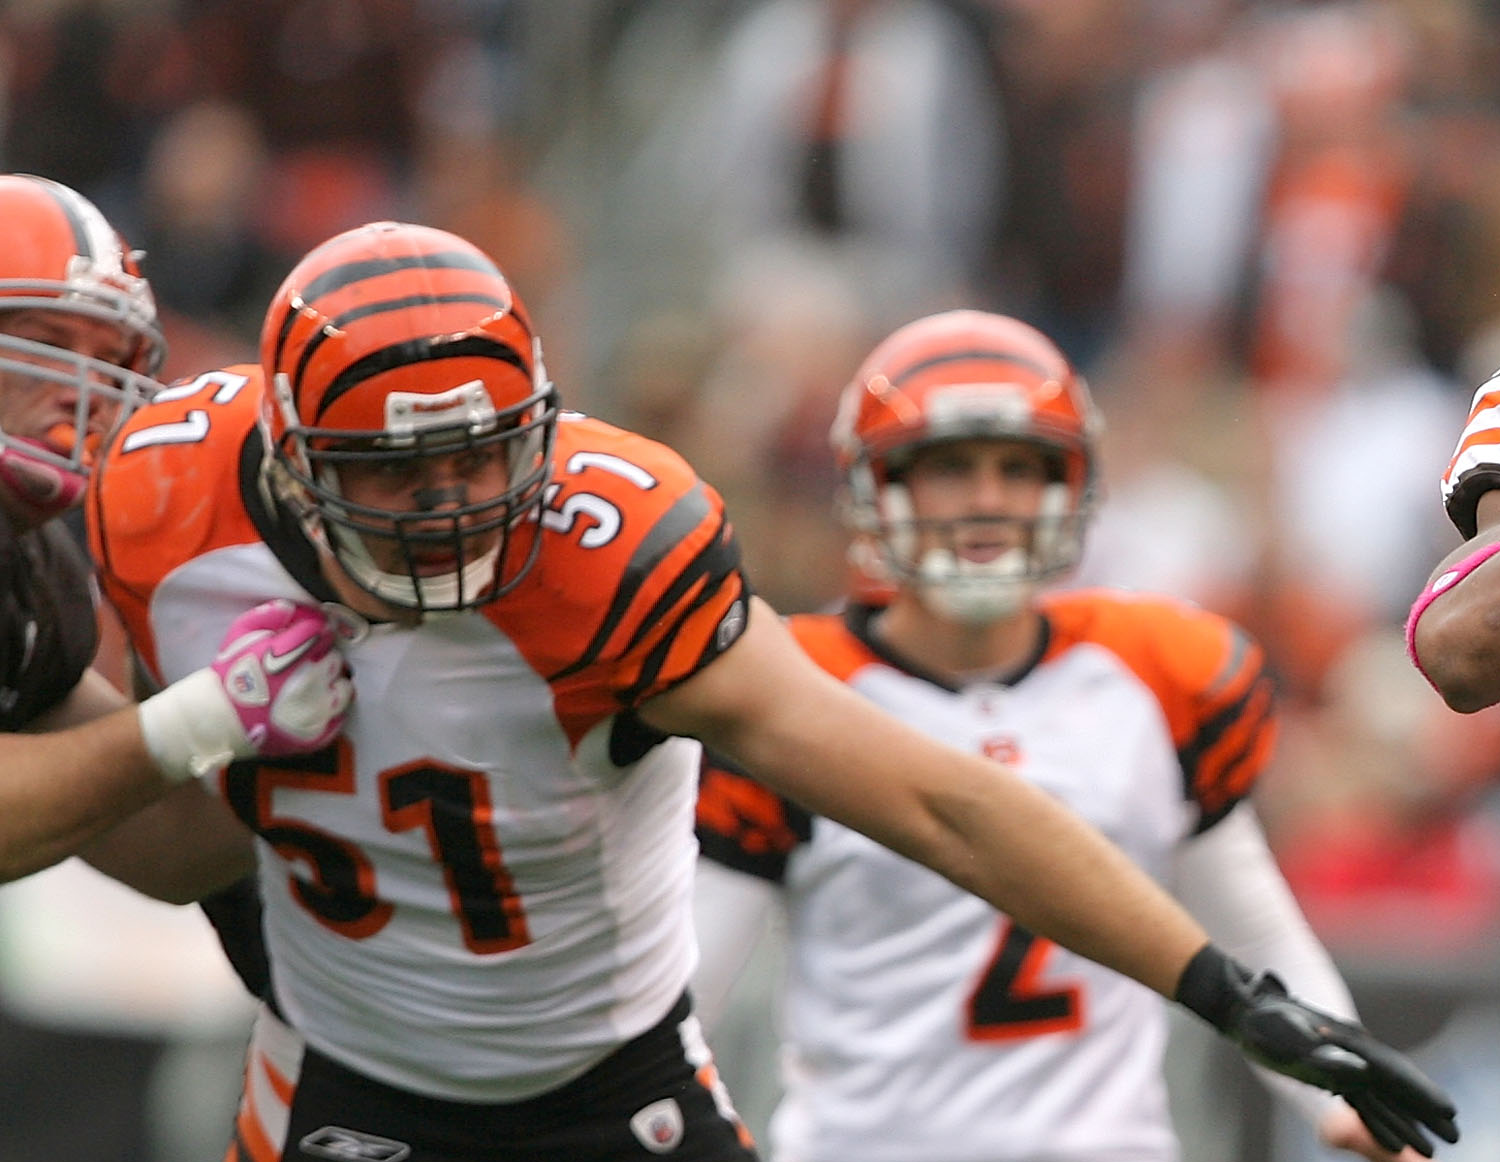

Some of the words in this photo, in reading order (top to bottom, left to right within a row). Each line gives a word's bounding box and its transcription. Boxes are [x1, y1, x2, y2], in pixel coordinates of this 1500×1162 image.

[120, 369, 250, 455] 51
[527, 450, 658, 550] 51
[218, 737, 534, 956] 51
